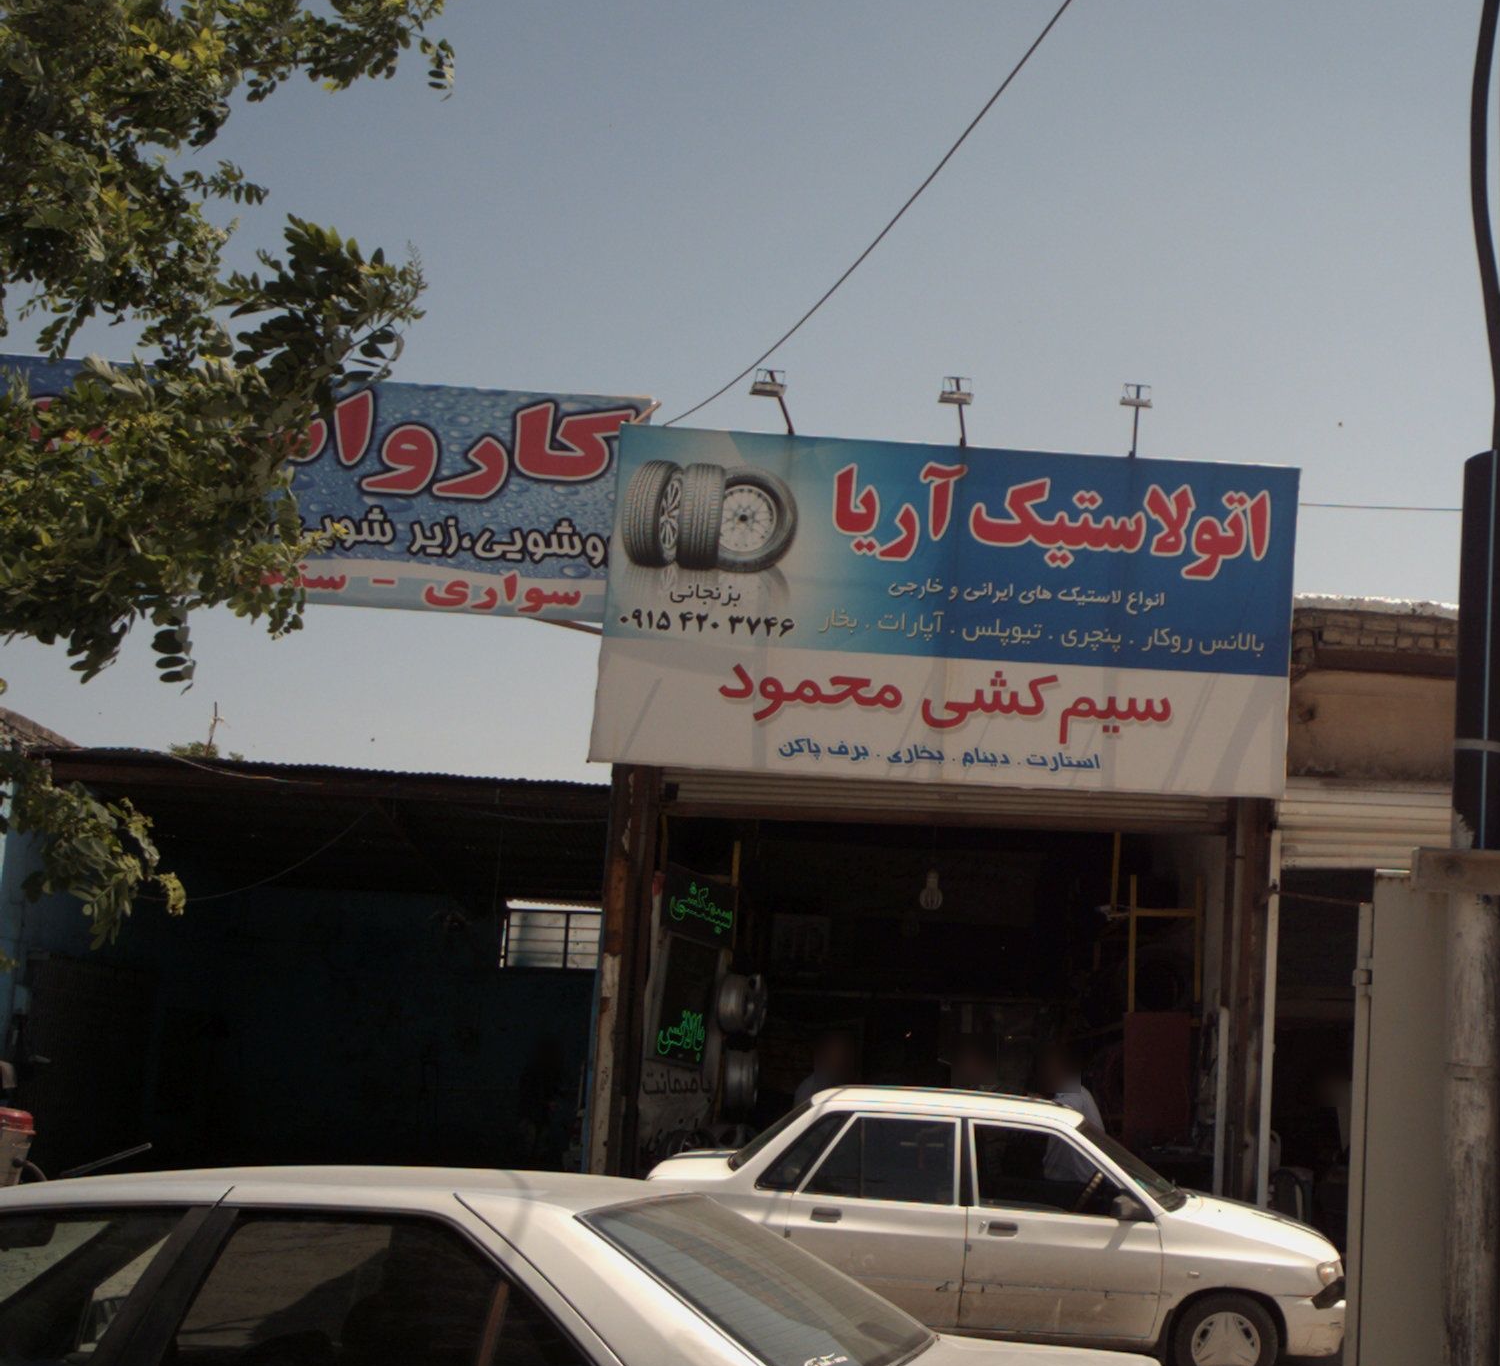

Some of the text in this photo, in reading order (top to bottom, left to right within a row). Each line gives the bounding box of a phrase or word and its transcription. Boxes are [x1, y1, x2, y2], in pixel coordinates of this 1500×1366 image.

[833, 461, 1271, 581] اتولاستیک آریا
[424, 572, 582, 612] سواری
[888, 578, 1166, 615] انواع لاستیک های ایرانی و خارجی
[620, 608, 795, 638] ۰۹۱۵ ۴۲۰ ۳۷۴۶
[818, 606, 1265, 657] بالانس روکار پنچری تیوپلس آپارات بخار
[718, 663, 1172, 744] سیم کشی محمود
[778, 736, 1101, 772] استارت دینام بخاری برف پاکن
